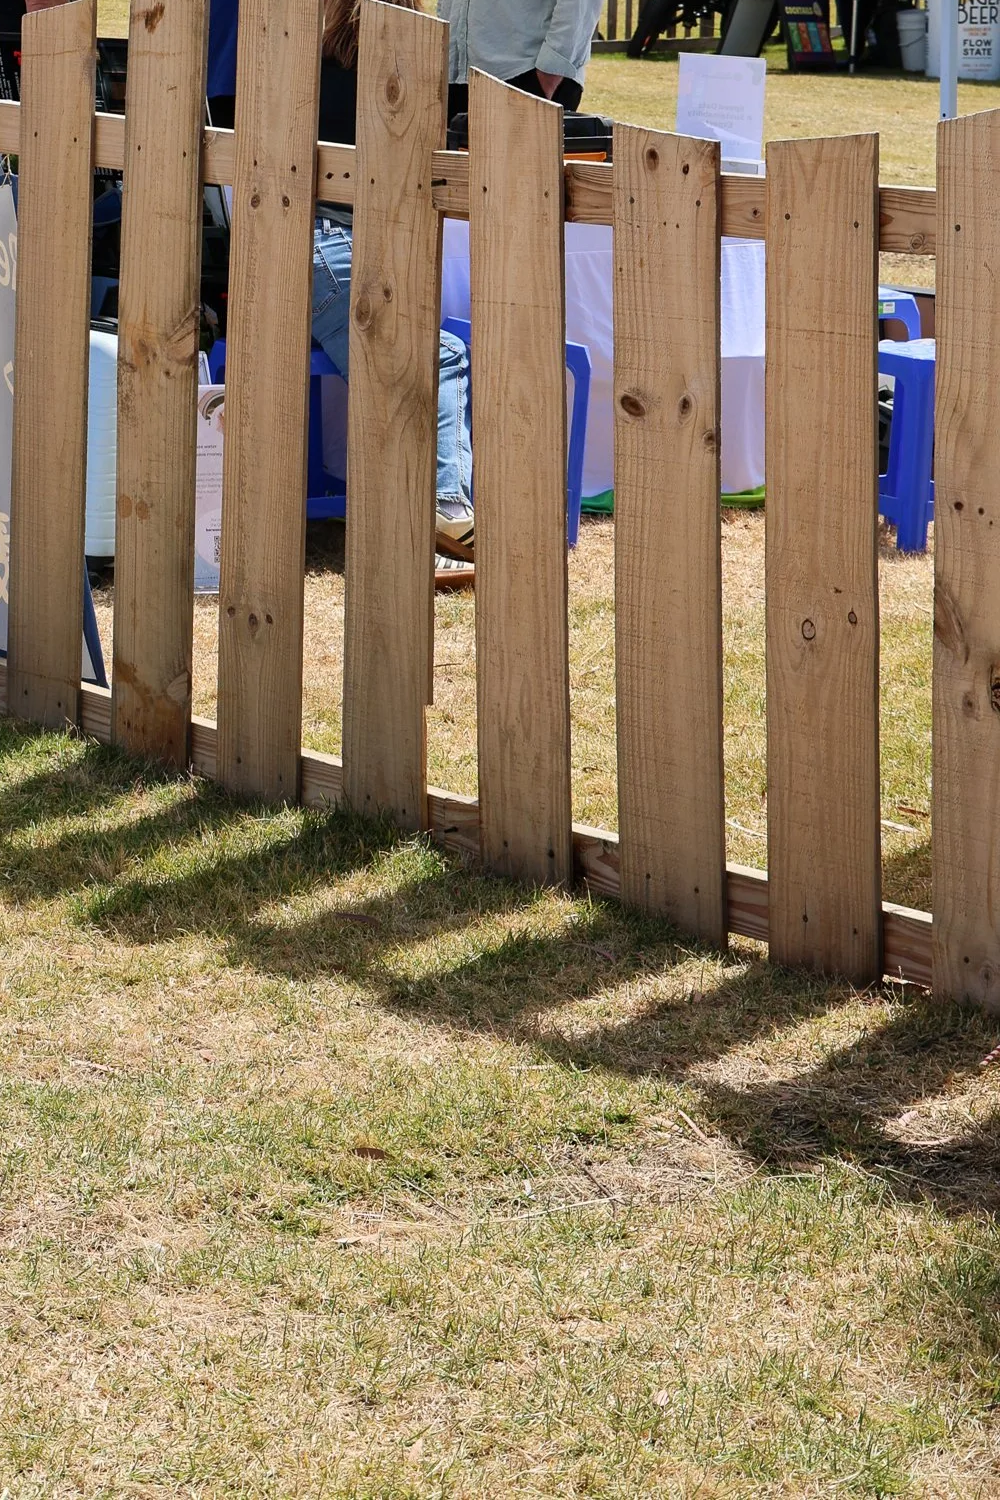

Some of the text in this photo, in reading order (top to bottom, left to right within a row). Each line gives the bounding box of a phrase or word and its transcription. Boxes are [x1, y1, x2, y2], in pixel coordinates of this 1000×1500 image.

[958, 4, 998, 24] BEER
[963, 39, 992, 47] FLOW
[962, 48, 992, 56] STATE
